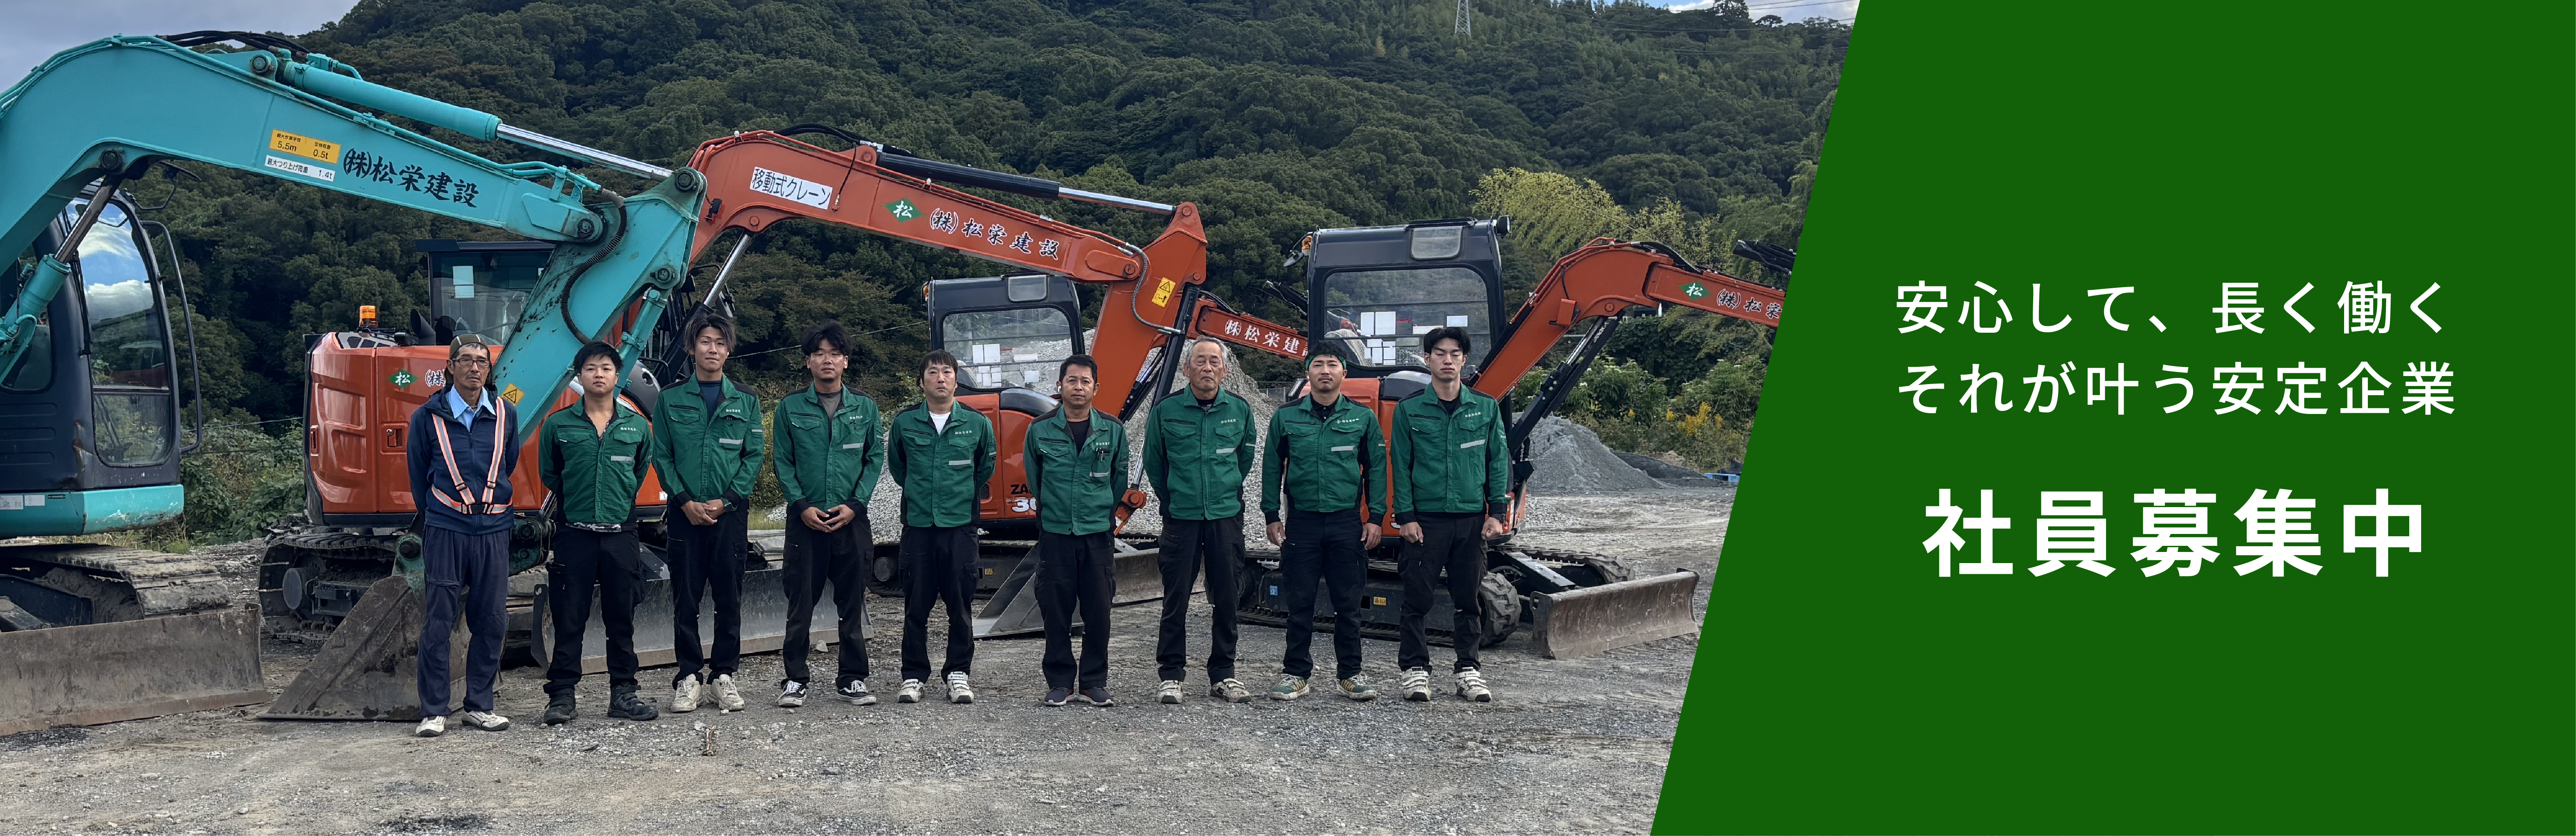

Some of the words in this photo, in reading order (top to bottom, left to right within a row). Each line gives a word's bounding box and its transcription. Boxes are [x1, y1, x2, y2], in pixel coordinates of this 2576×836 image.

[278, 141, 297, 151] 5.5m
[313, 149, 329, 159] 0.5t
[319, 170, 332, 179] 1.4t
[343, 147, 479, 208] (株)松栄建設
[752, 169, 831, 205] 移動式クレーン
[894, 200, 913, 218] 松
[1686, 282, 1703, 296] 松
[395, 372, 411, 386] 松
[1010, 484, 1032, 495] ZA
